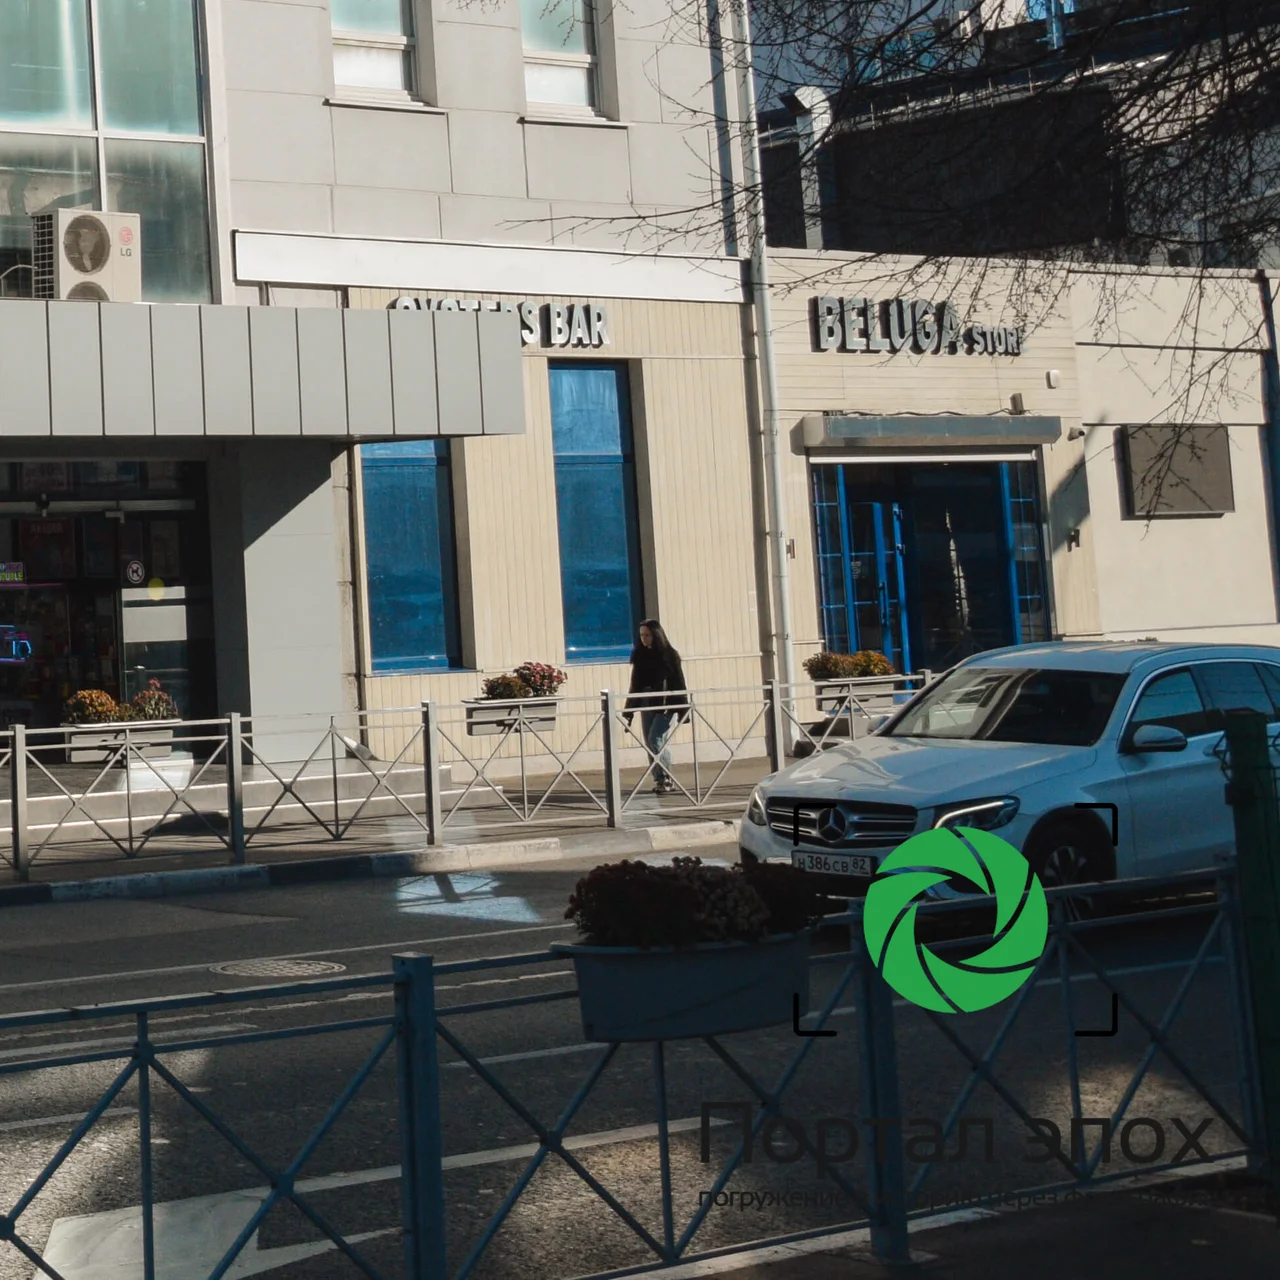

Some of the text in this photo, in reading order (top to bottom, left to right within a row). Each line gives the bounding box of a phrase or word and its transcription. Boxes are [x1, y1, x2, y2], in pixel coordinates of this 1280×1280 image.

[120, 247, 132, 257] LG
[545, 303, 611, 347] BAR
[810, 296, 966, 353] BELUGA
[852, 858, 867, 870] 82
